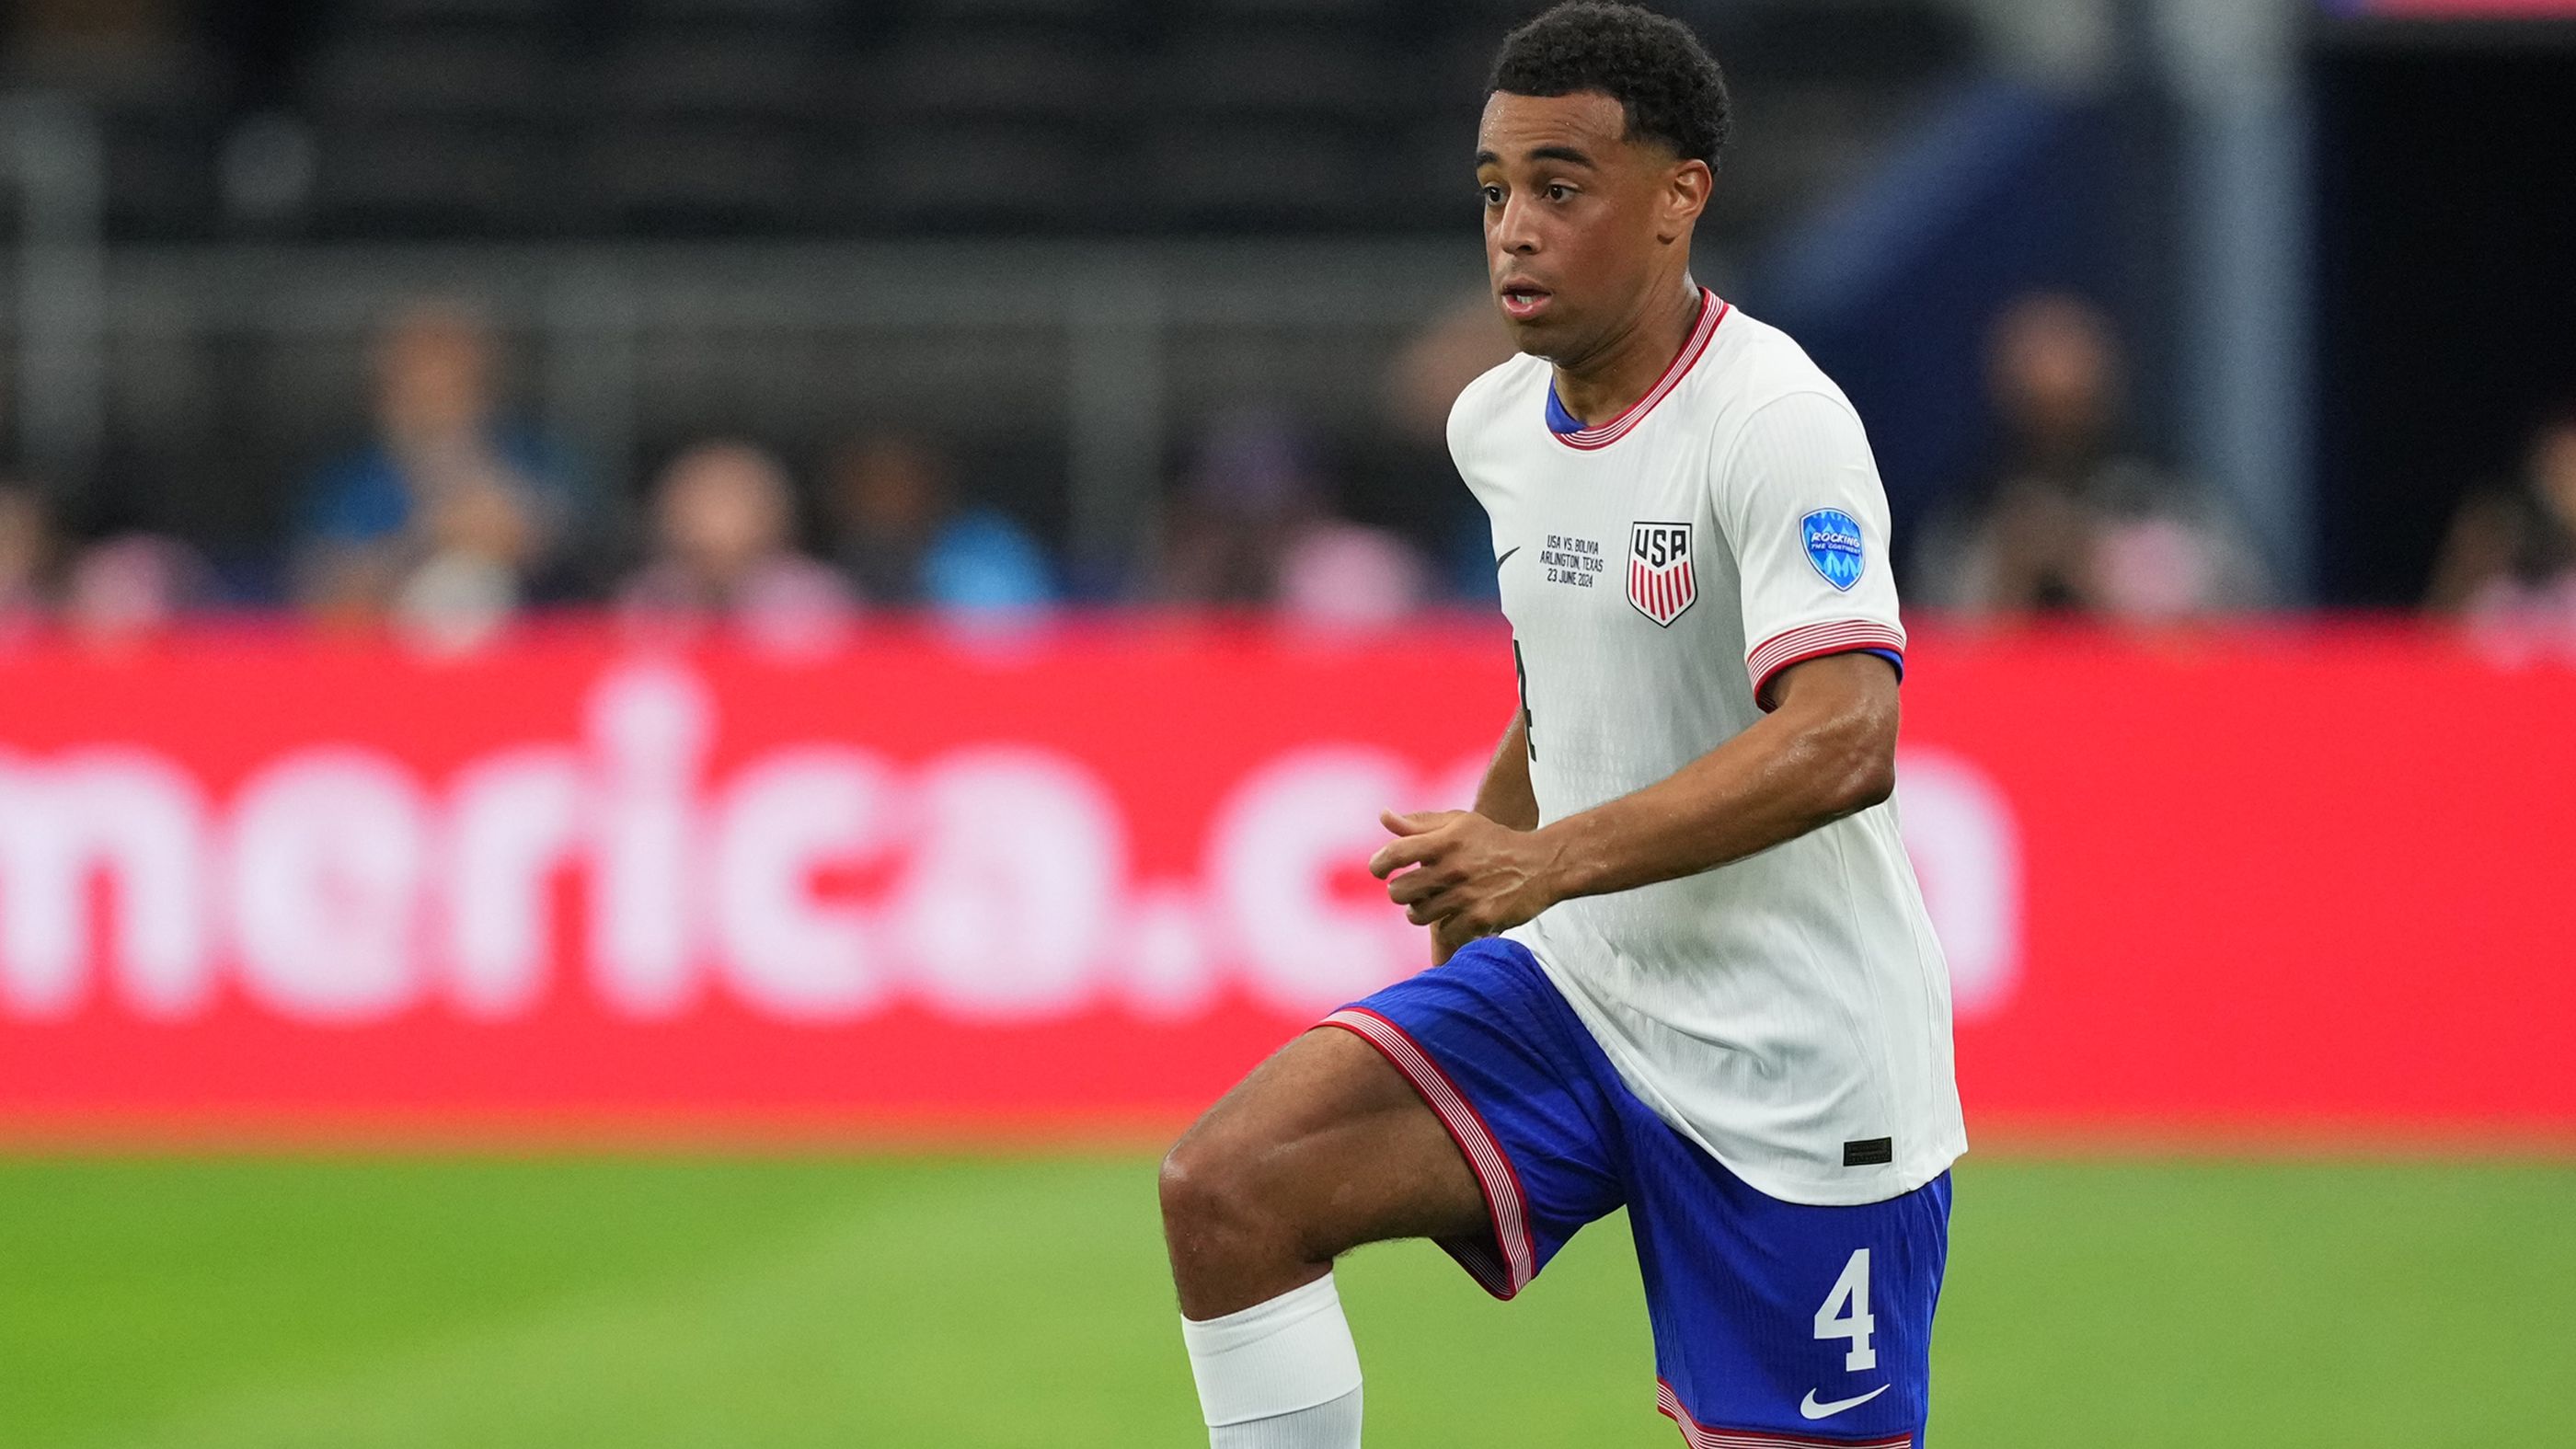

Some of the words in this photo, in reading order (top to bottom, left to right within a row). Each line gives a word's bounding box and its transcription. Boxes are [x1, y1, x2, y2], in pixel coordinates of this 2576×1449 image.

[1547, 535, 1561, 549] USA
[1563, 537, 1573, 552] VS.
[1575, 538, 1599, 555] BOLIVIA
[1634, 528, 1686, 569] USA
[1811, 532, 1860, 548] ROCKING
[1582, 556, 1604, 573] TEXAS
[1547, 568, 1558, 582] 23
[1558, 569, 1577, 585] JUNE
[1578, 572, 1593, 588] 2024
[1813, 1248, 1876, 1373] 4
